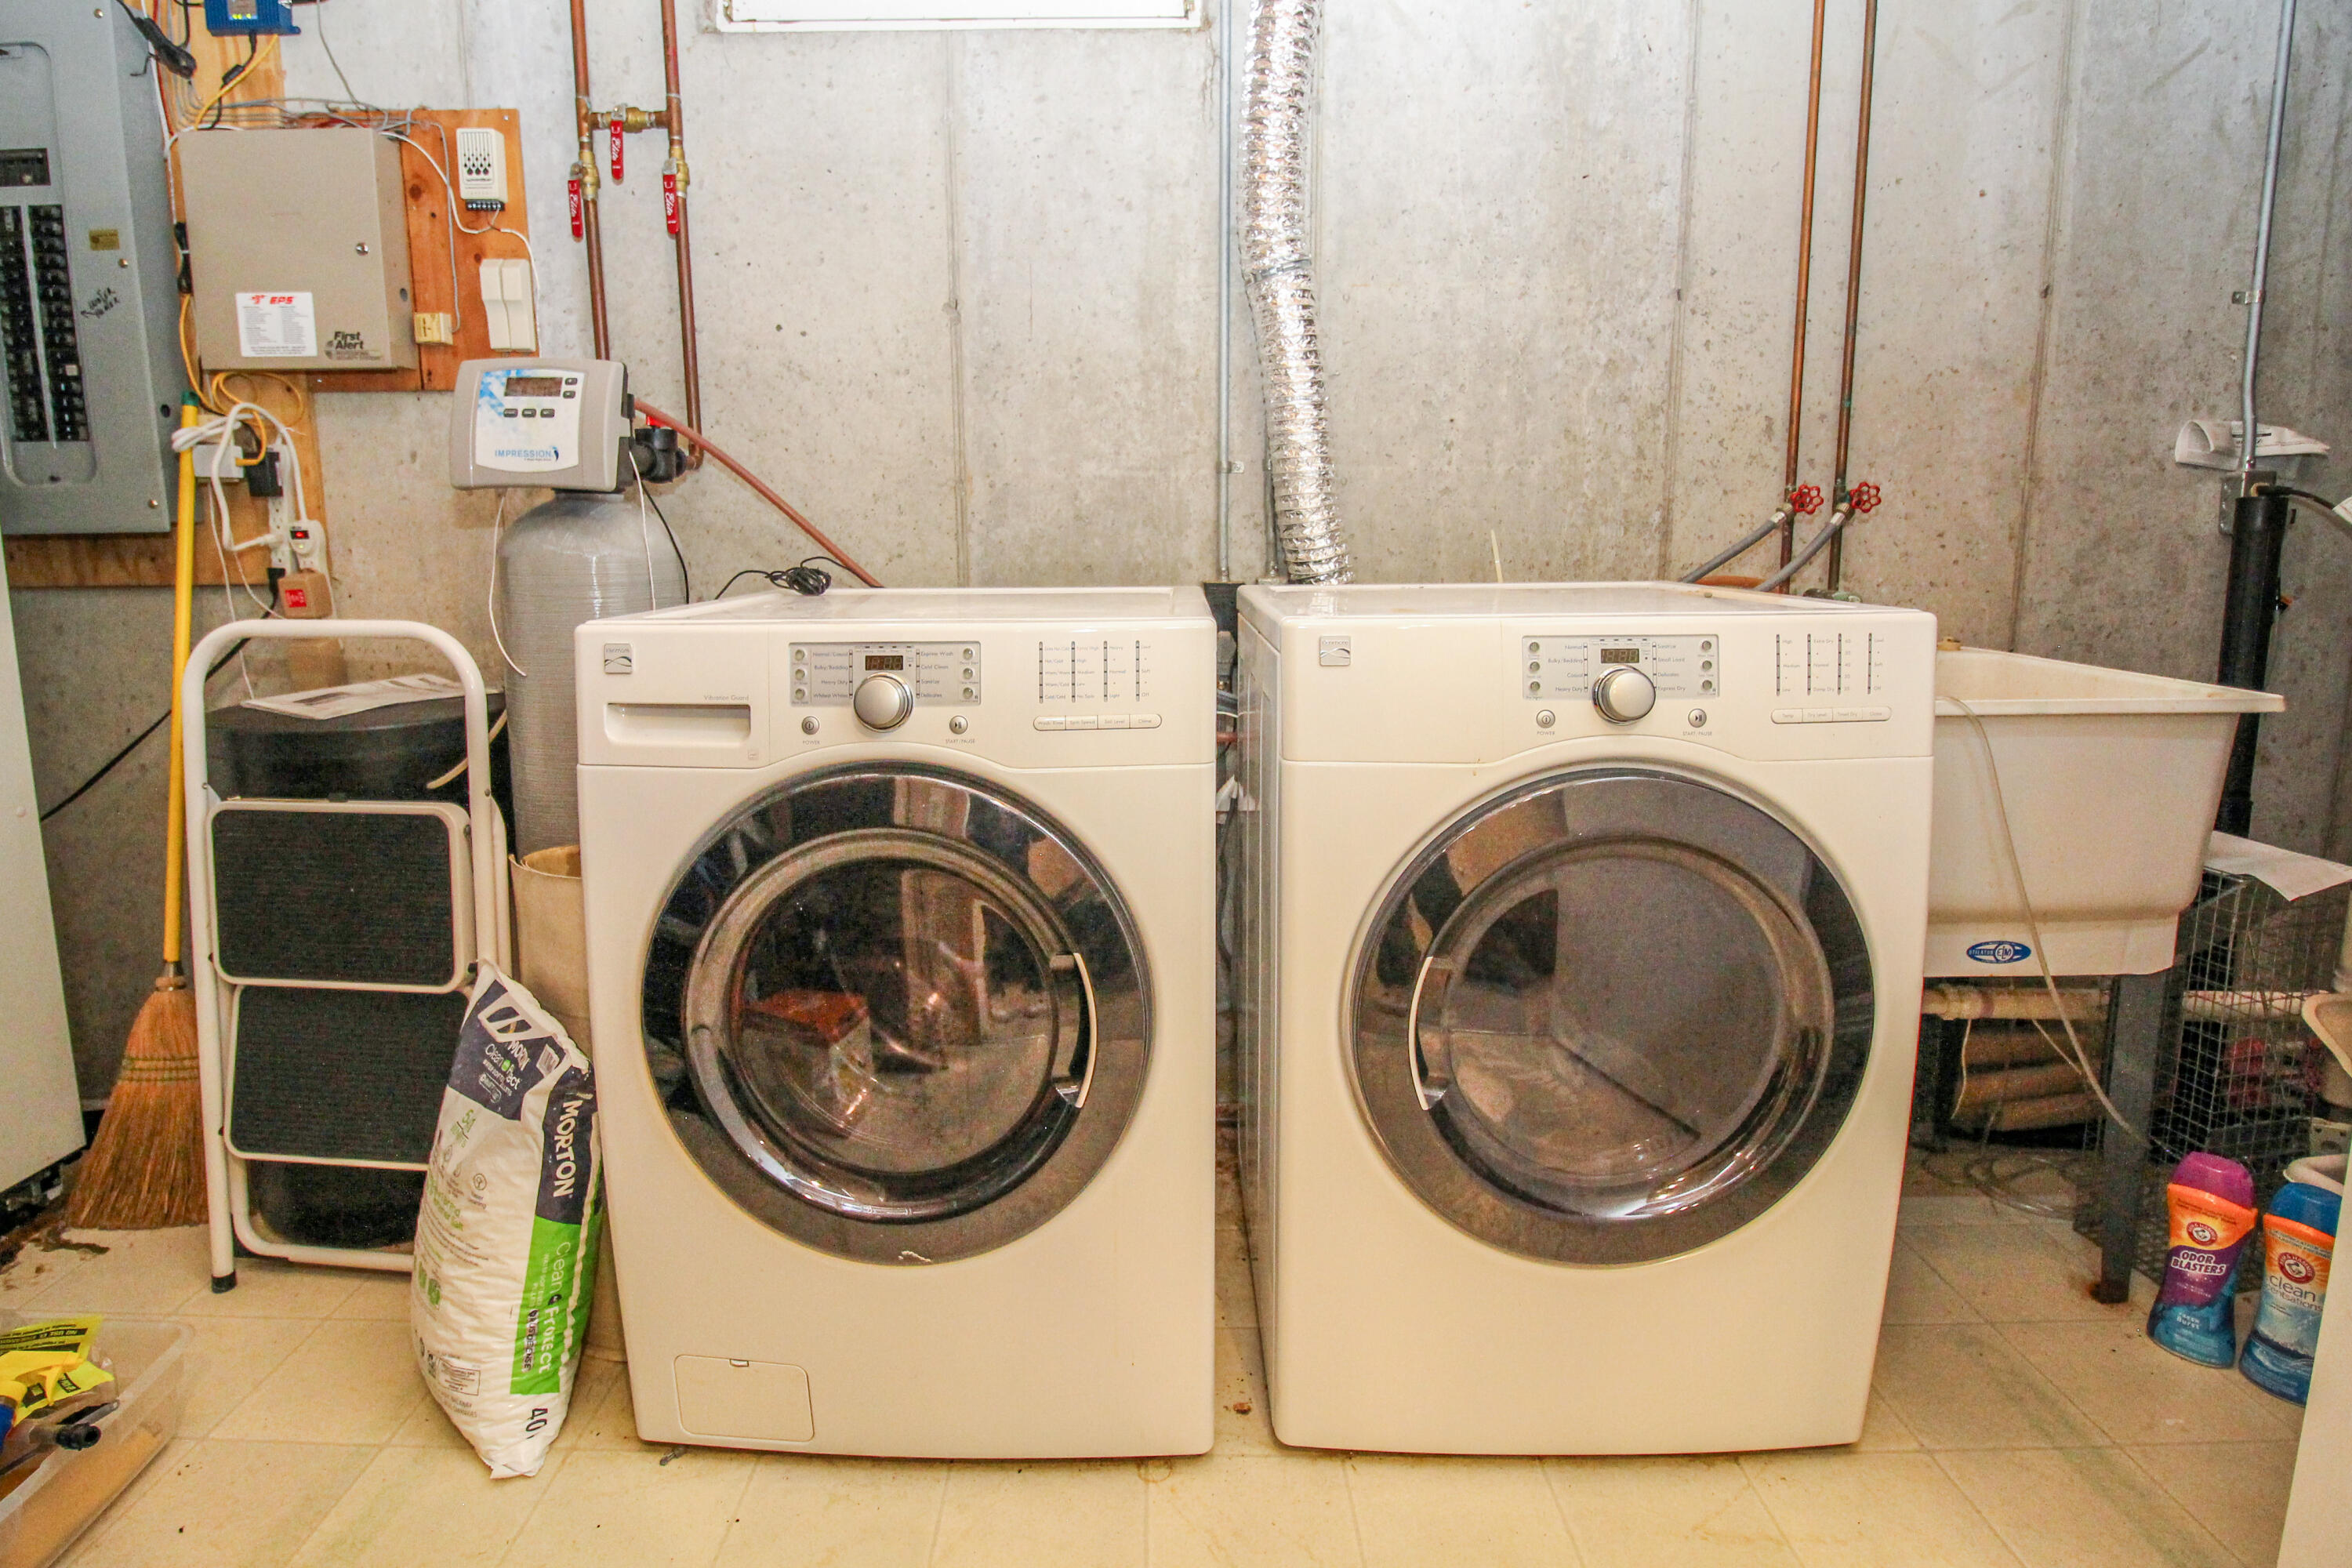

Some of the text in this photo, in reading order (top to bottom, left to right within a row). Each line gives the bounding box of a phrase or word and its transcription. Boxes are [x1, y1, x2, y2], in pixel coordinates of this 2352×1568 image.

[334, 331, 361, 340] First
[335, 340, 364, 350] Alert
[495, 449, 553, 458] IMPRESSION
[553, 1100, 583, 1197] MORTON
[2180, 1250, 2216, 1265] ODOR
[550, 1242, 571, 1294] Clean
[2171, 1257, 2227, 1276] BLASTERS
[2270, 1275, 2316, 1302] clean
